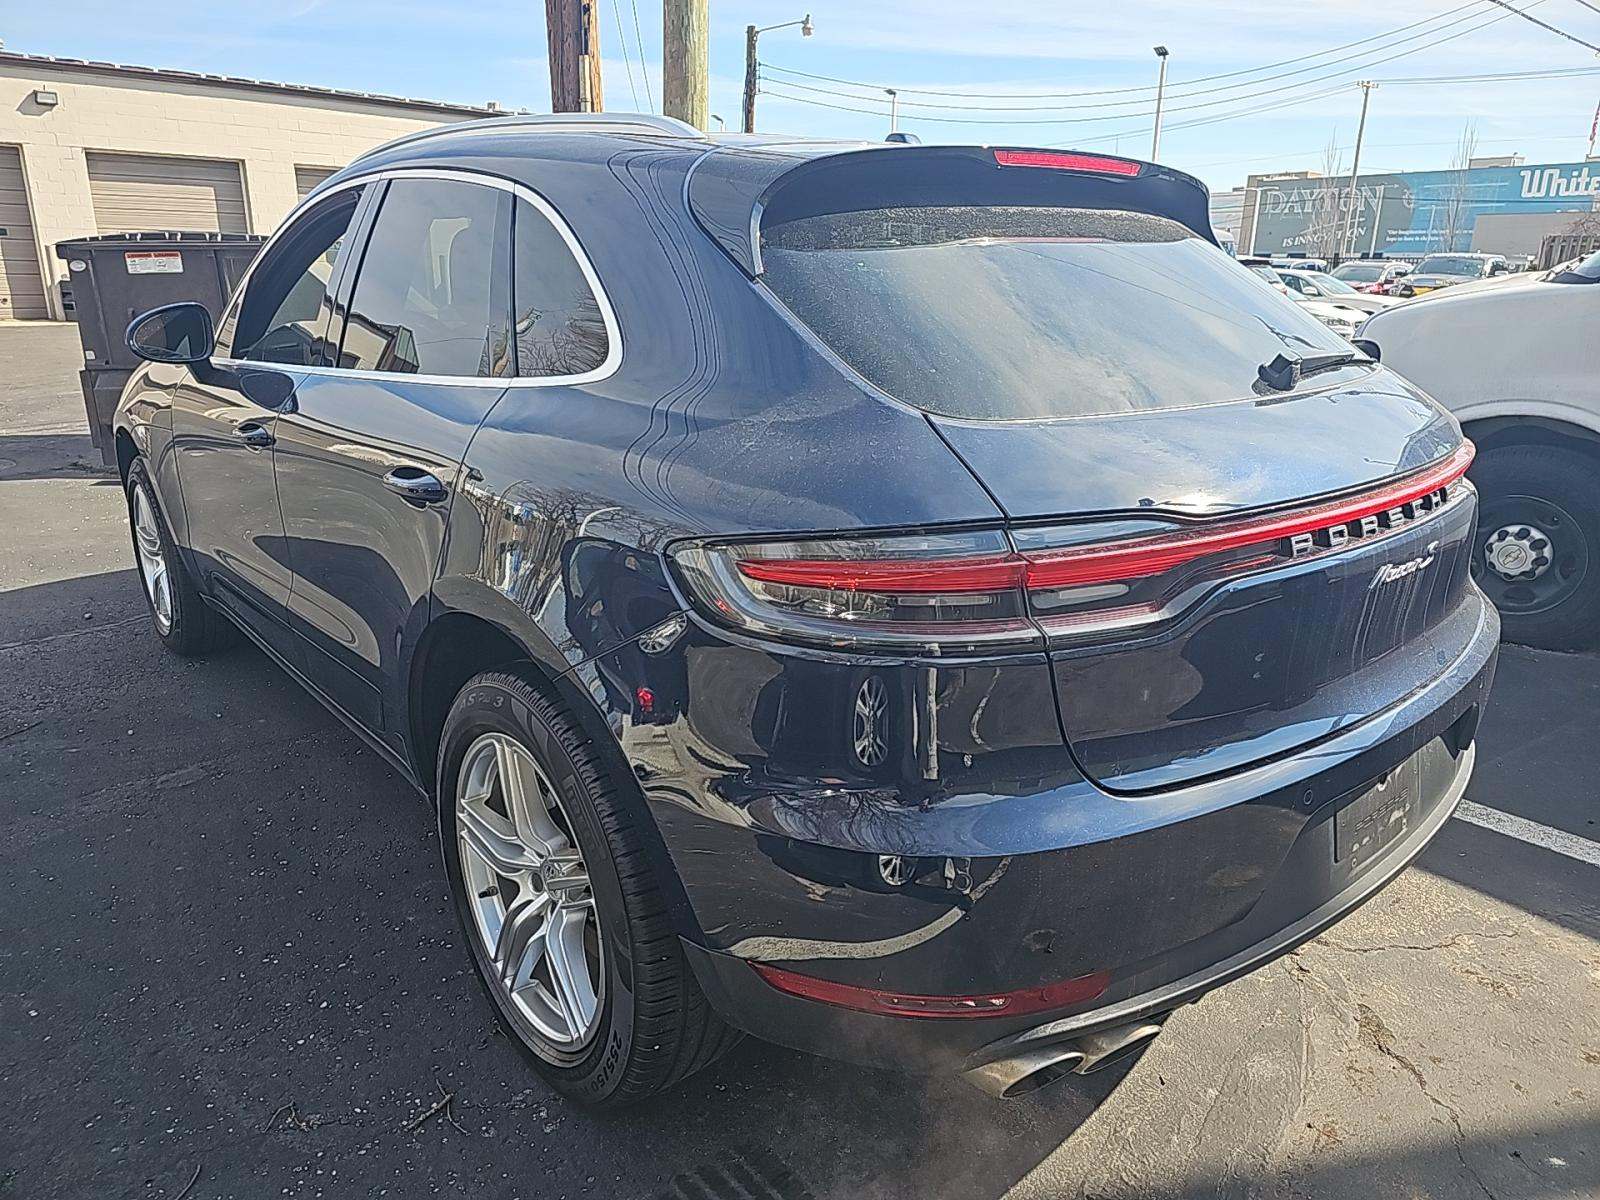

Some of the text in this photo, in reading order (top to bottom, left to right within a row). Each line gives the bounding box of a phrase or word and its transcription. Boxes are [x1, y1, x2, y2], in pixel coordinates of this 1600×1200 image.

[1520, 167, 1600, 198] White
[1264, 186, 1384, 214] DAYTON
[1282, 237, 1294, 248] IS
[1294, 226, 1367, 247] INNOVTON
[1290, 488, 1449, 558] PORSCH
